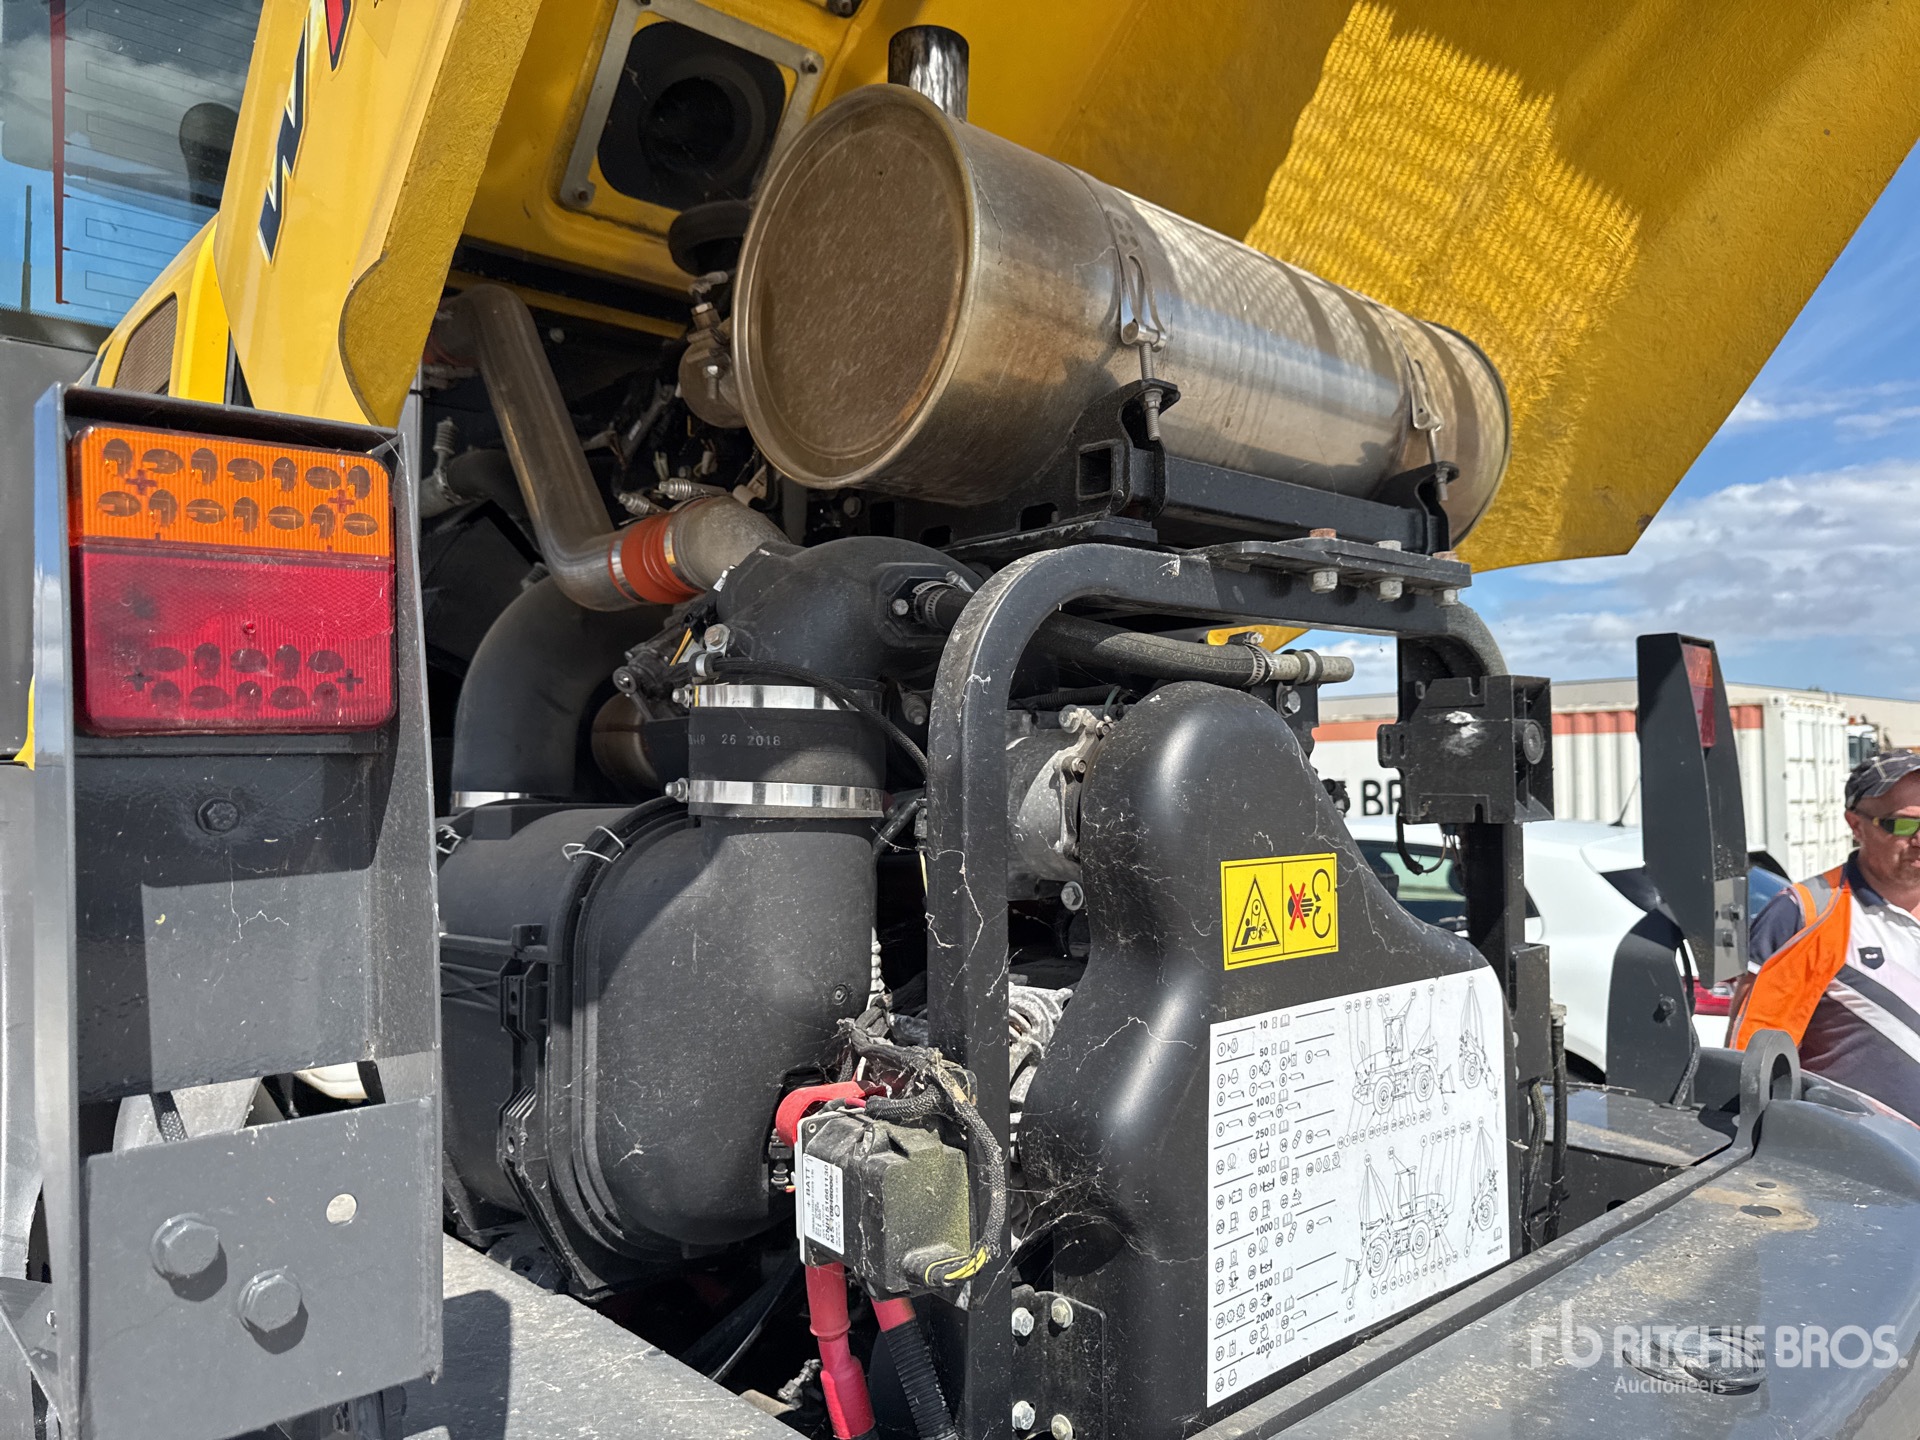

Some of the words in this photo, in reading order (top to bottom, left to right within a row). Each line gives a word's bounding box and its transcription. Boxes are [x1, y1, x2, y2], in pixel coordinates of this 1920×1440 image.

[721, 733, 737, 745] 26
[747, 735, 781, 746] 2018
[1260, 1020, 1268, 1030] 10
[1259, 1047, 1268, 1057] 50
[1256, 1096, 1270, 1107] 100
[1256, 1128, 1269, 1139] 250
[1258, 1164, 1270, 1175] 500
[1256, 1221, 1273, 1236] 1000
[1255, 1277, 1273, 1292] 1500
[1256, 1308, 1274, 1324] 2000
[1256, 1340, 1274, 1355] 4000
